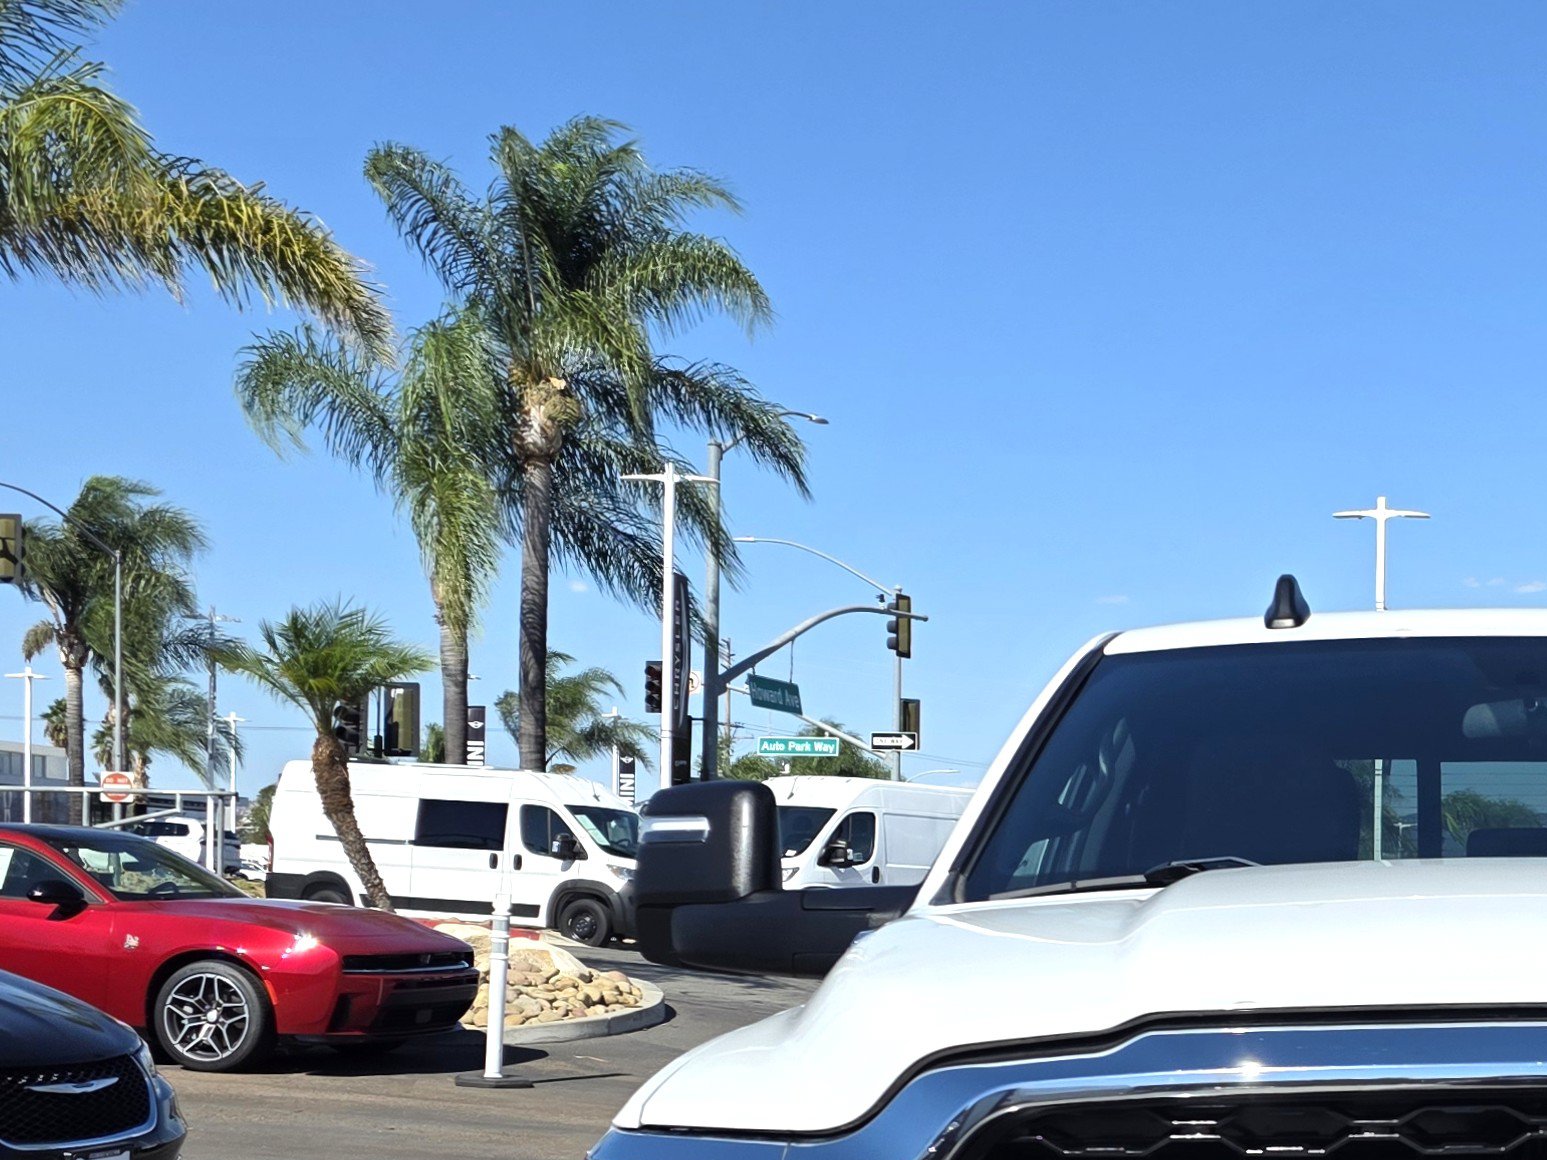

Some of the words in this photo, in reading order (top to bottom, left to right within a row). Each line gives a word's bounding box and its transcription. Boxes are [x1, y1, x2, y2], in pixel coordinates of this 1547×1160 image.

[672, 599, 681, 710] CHRYSLER
[750, 680, 783, 704] Howard
[785, 689, 800, 708] Ave
[466, 740, 485, 766] INI
[761, 741, 785, 752] Auto
[788, 741, 811, 752] Park
[813, 741, 835, 754] Way
